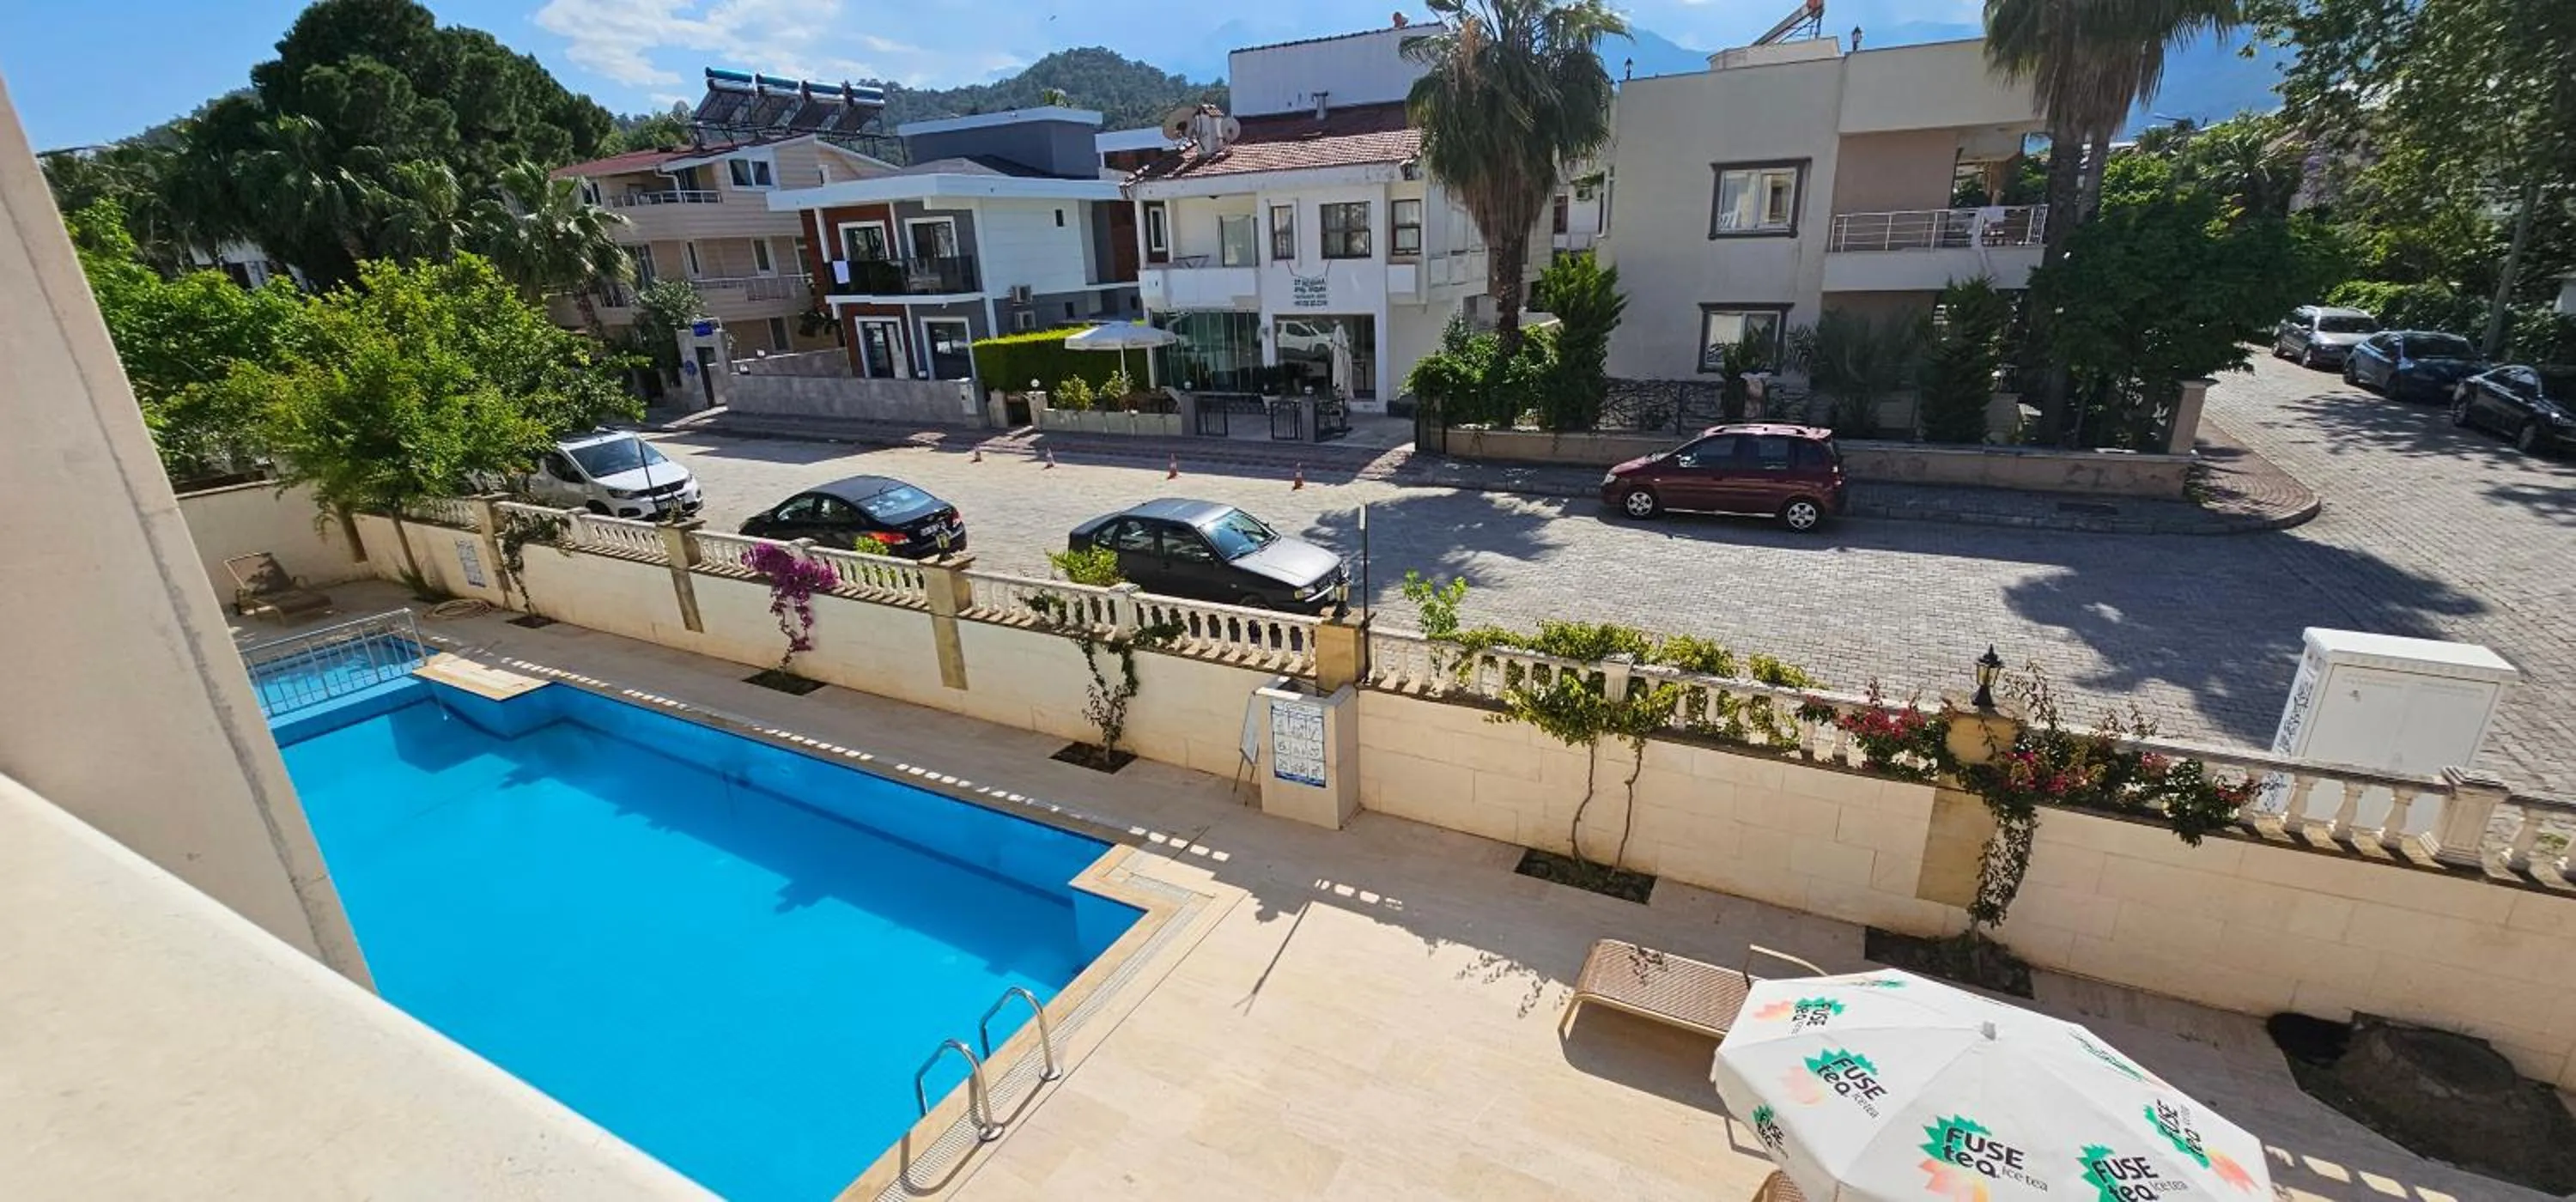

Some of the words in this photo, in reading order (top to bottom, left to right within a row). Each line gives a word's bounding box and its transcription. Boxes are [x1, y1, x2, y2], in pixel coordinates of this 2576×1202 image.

[1817, 1065, 1849, 1097] tea
[1831, 1058, 1888, 1101] FUSE
[1759, 1112, 1785, 1146] FUSE
[1942, 1144, 2001, 1179] tea
[1945, 1126, 2025, 1170] FUSE
[2026, 1175, 2049, 1193] tea
[2091, 1156, 2160, 1184] FUSE
